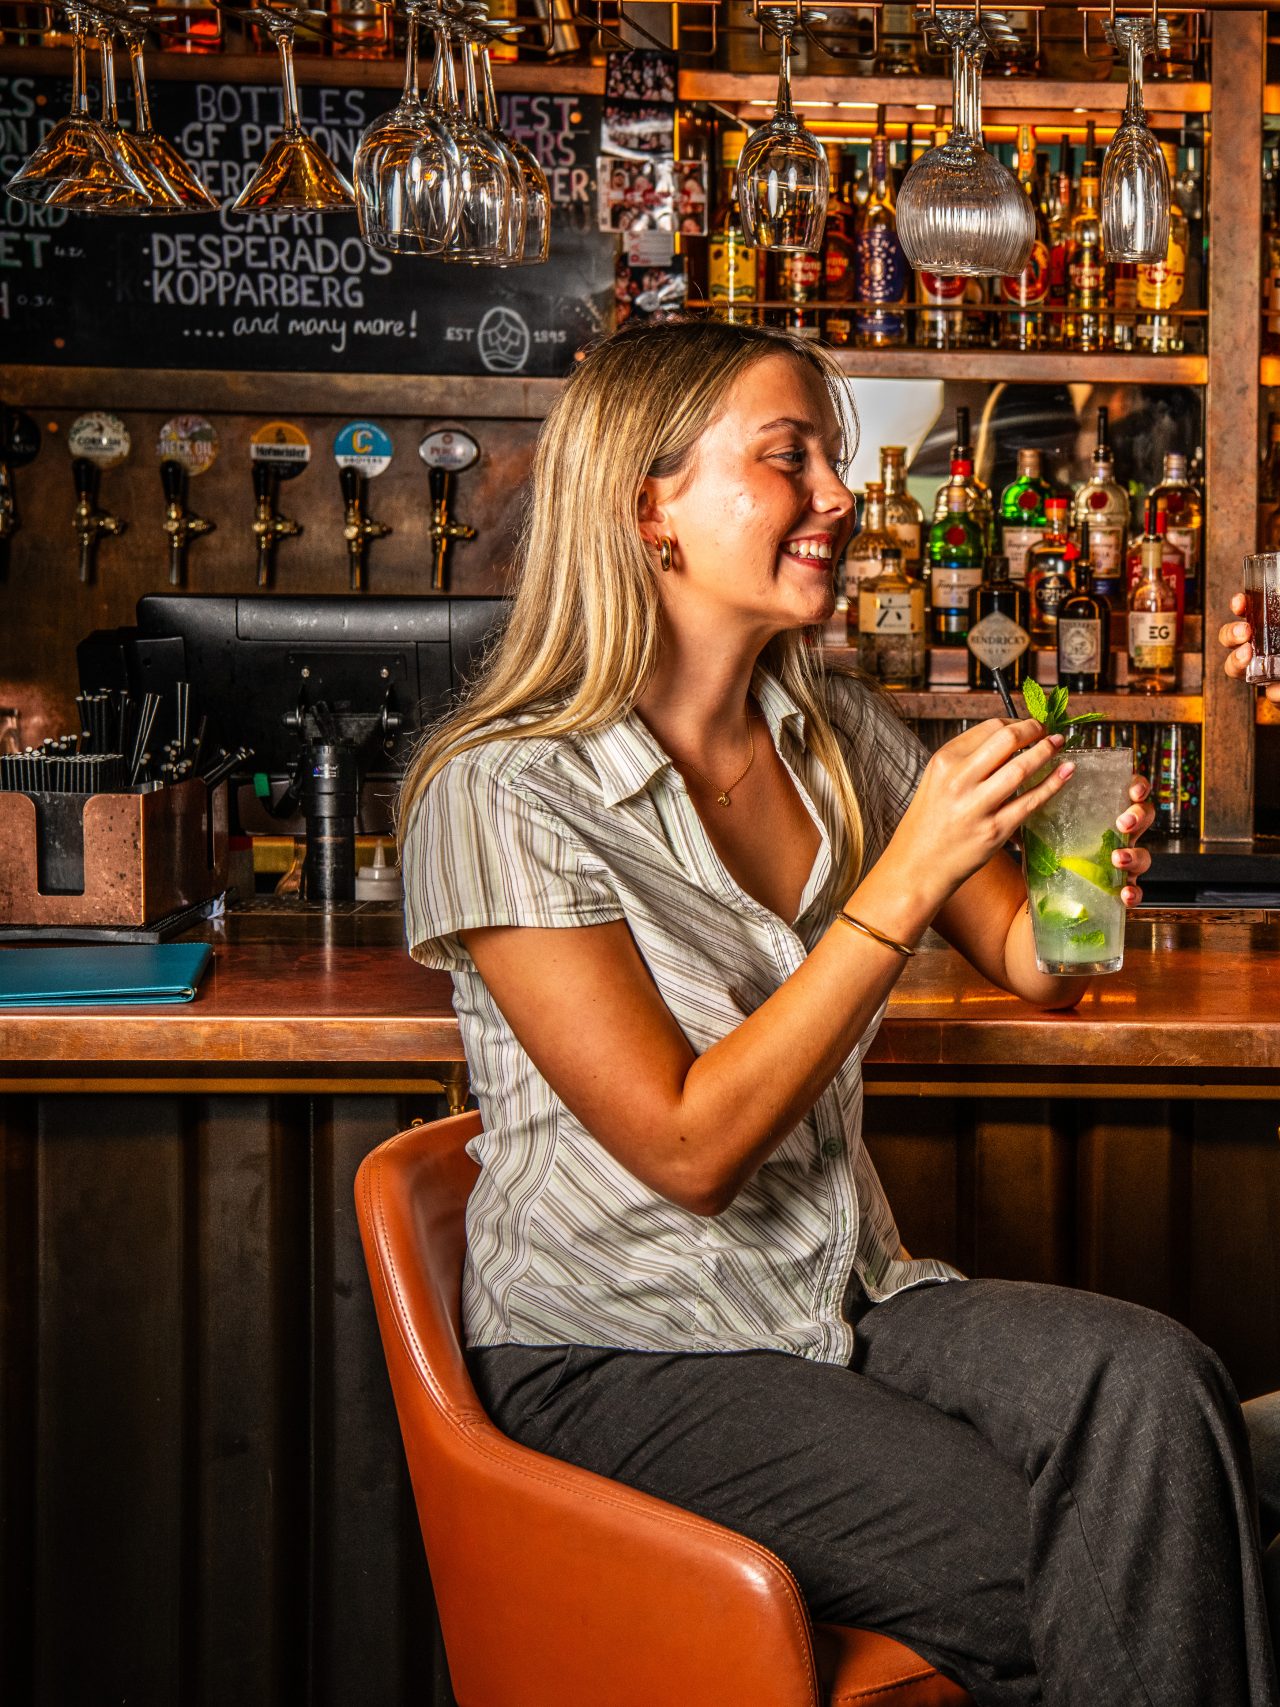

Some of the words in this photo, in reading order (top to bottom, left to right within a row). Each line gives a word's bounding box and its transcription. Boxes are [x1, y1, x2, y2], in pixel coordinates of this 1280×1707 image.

[196, 84, 365, 126] BOTTLES
[152, 232, 392, 275] DESPERADOS
[152, 269, 364, 308] KOPPARBERG
[232, 310, 280, 336] and
[288, 317, 347, 353] many
[353, 309, 417, 340] more!
[446, 326, 475, 341] EST
[1149, 626, 1170, 639] EG
